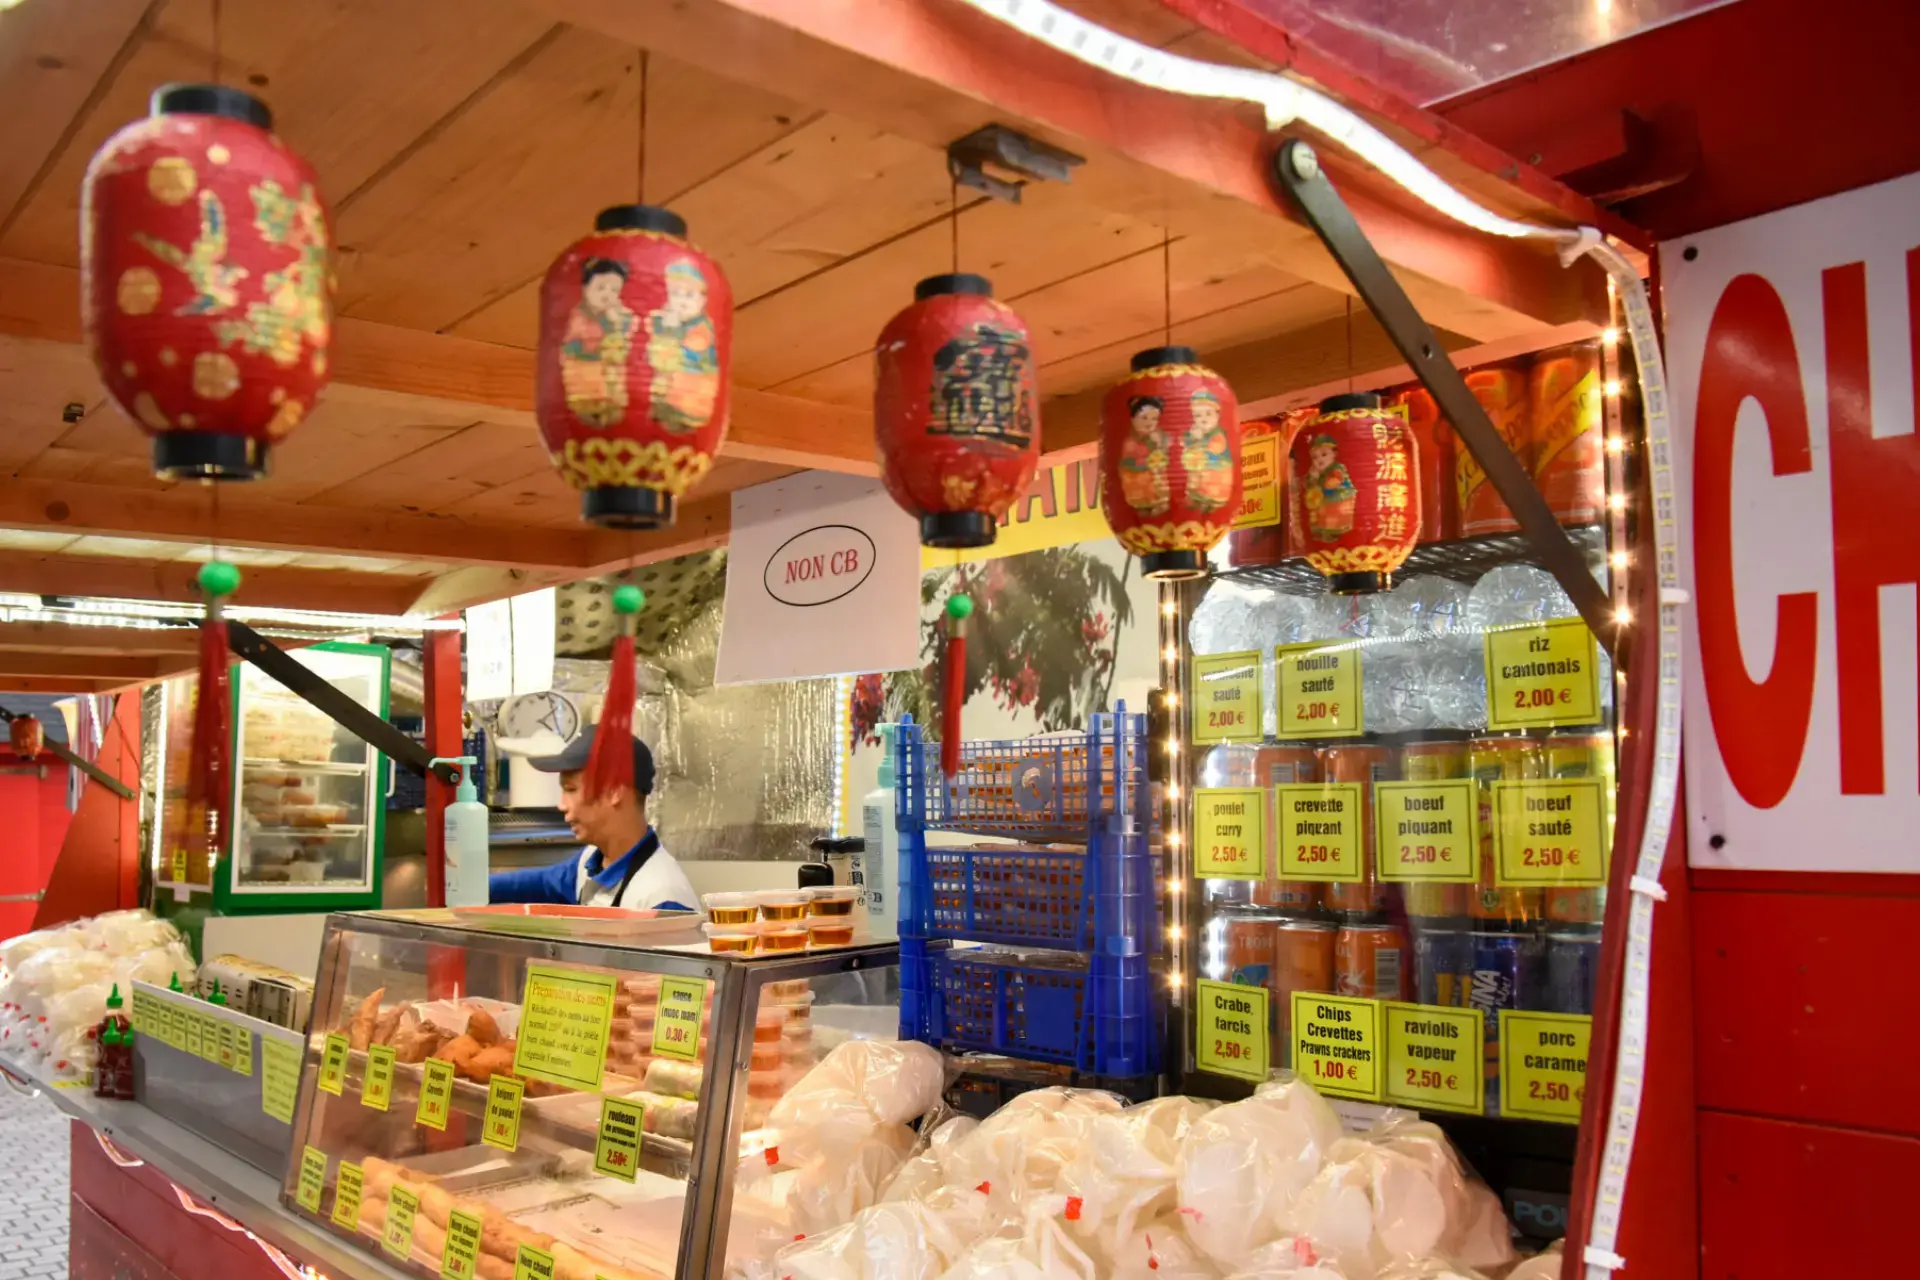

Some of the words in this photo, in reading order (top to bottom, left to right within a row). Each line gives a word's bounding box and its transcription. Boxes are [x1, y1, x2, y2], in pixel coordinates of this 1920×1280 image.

[785, 555, 825, 584] NON
[831, 548, 859, 575] CB
[1529, 636, 1551, 653] riz
[1297, 655, 1340, 672] nouille
[1502, 658, 1581, 679] cantonais
[1302, 676, 1336, 693] sauté
[1213, 686, 1242, 702] sauté
[1209, 710, 1235, 728] 2,00
[1297, 702, 1327, 720] 2,00
[1213, 801, 1245, 816] poulet
[1294, 799, 1344, 813] crevette
[1404, 795, 1445, 811] boeuf
[1526, 794, 1572, 811] boeuf
[1216, 823, 1243, 838] curry
[1296, 820, 1342, 836] piquant
[1398, 819, 1453, 837] piquant
[1528, 819, 1572, 836] sauté
[1212, 846, 1237, 862] 2,50
[1297, 845, 1328, 863] 2,50
[1400, 845, 1437, 864] 2,50
[1523, 847, 1563, 867] 2,50
[672, 990, 692, 1003] sauce
[1215, 995, 1252, 1014] Crabe
[1317, 1005, 1352, 1023] Chips
[1215, 1016, 1251, 1035] farcis
[1307, 1022, 1363, 1042] Crevettes
[1404, 1020, 1459, 1039] raviolis
[1538, 1031, 1576, 1047] porc
[1214, 1039, 1241, 1059] 2,50
[1300, 1039, 1331, 1057] Prawns
[1333, 1045, 1371, 1062] crackers
[1407, 1044, 1456, 1062] vapeur
[1313, 1059, 1344, 1079] 1,00
[1524, 1054, 1586, 1073] carame
[1406, 1068, 1442, 1089] 2,50
[1529, 1080, 1569, 1101] 2,50
